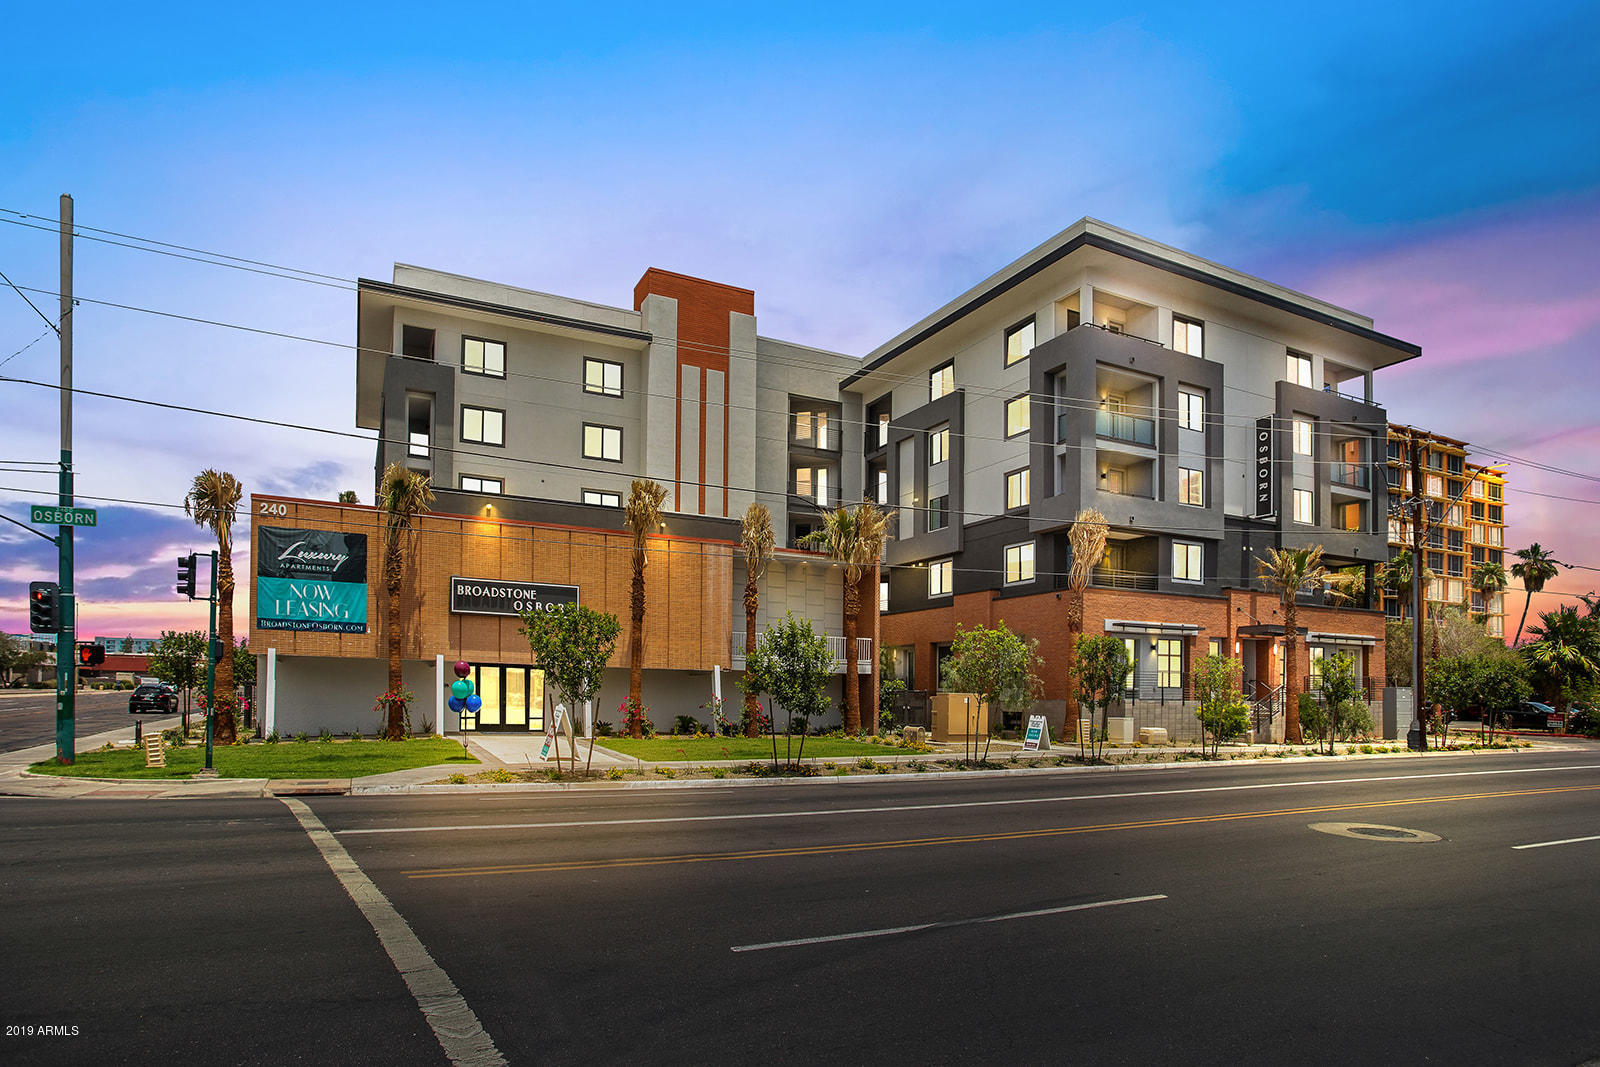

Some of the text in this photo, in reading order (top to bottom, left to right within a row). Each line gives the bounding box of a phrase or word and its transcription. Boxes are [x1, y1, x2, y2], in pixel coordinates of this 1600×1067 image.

[1259, 431, 1269, 502] OSBORN
[33, 510, 94, 524] OSBORN
[260, 502, 287, 516] 240
[277, 541, 349, 572] Luxury
[279, 563, 331, 572] APARTMENTS
[290, 583, 336, 601] NOW
[456, 584, 537, 600] BROADSTONE
[275, 599, 349, 619] LEASING
[513, 600, 567, 614] OSBOR
